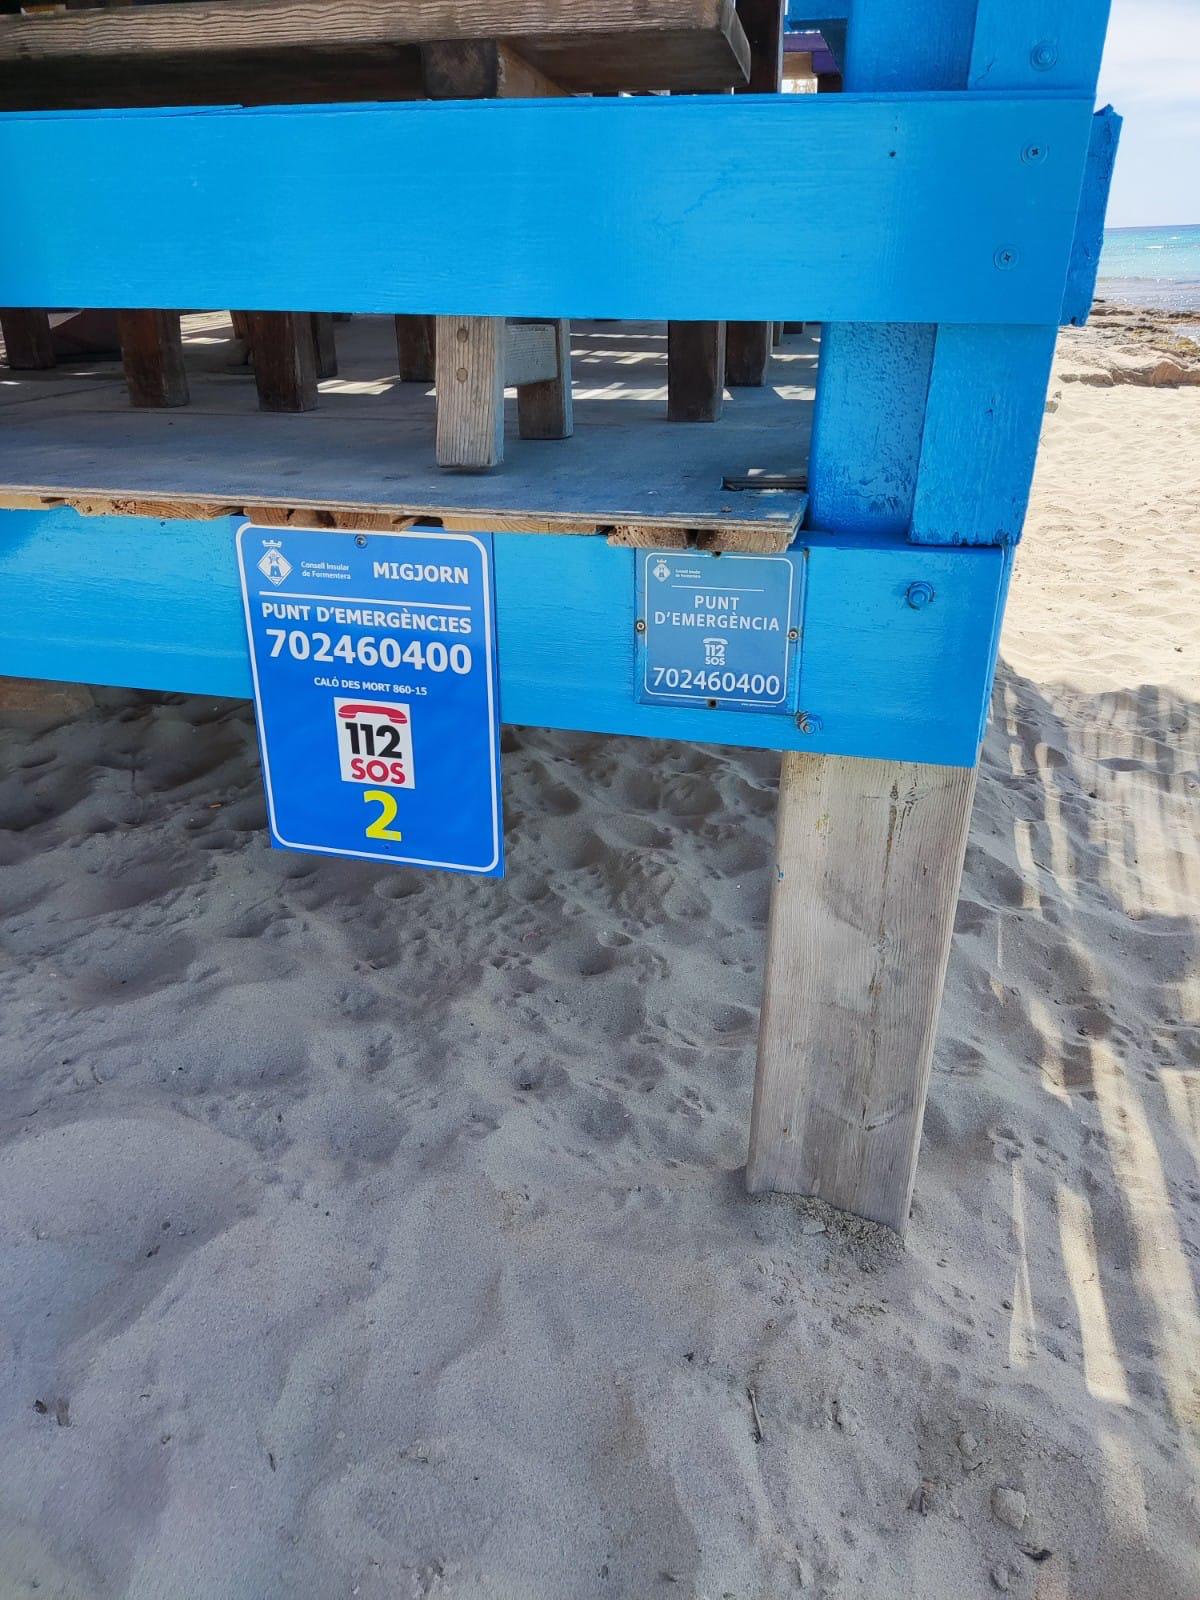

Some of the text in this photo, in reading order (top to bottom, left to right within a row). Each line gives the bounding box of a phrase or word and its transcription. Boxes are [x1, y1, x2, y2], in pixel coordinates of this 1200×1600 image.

[300, 560, 350, 571] Consell Insular
[311, 571, 352, 580] Formentera
[373, 561, 469, 585] MIGJORN
[262, 602, 311, 621] PUNT
[694, 595, 740, 611] PUNT
[265, 628, 473, 675] 702460400
[704, 644, 725, 657] 112
[704, 656, 726, 666] SOS
[313, 676, 428, 697] CALÓ DES MORT 860-15
[653, 667, 780, 696] 702460400
[345, 722, 403, 760] 112
[350, 757, 406, 785] SOS
[363, 789, 402, 842] 2
